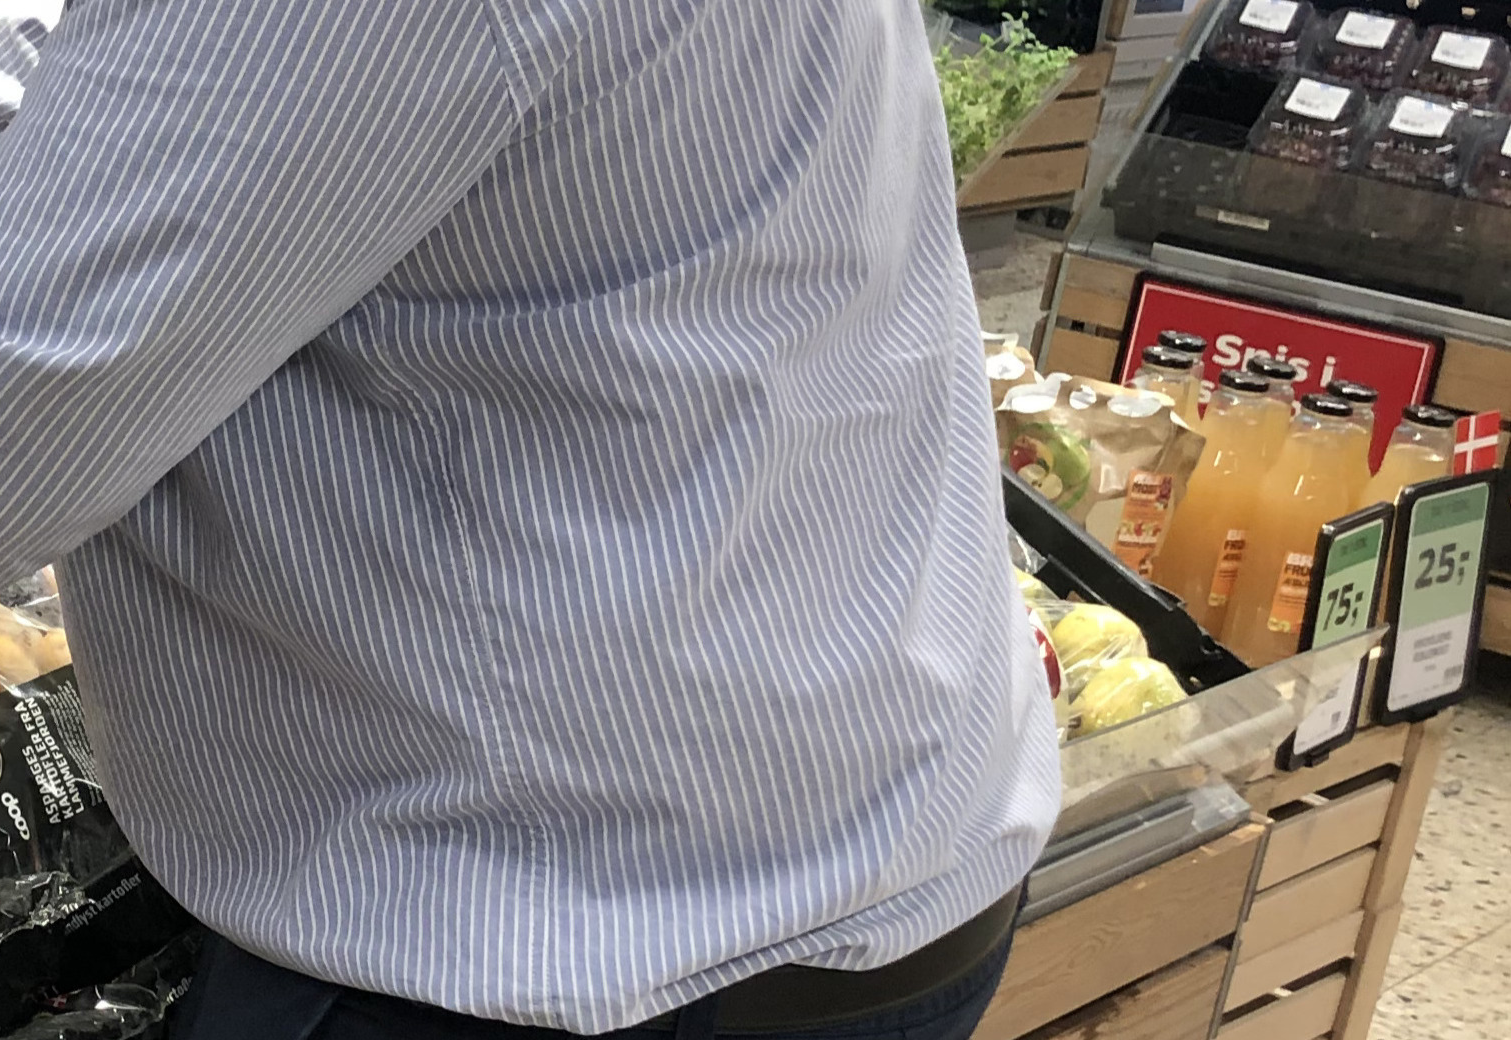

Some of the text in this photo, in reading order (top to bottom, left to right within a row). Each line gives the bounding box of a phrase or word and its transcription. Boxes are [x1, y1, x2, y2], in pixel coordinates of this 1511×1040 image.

[1320, 356, 1337, 388] i
[14, 700, 35, 732] FRA
[22, 745, 62, 824] ASPARGES
[25, 697, 85, 815] LAMMEFJORDEN
[30, 730, 76, 821] KARTOFLER
[1, 791, 31, 841] coop
[65, 872, 143, 936] ndlyst kartofler
